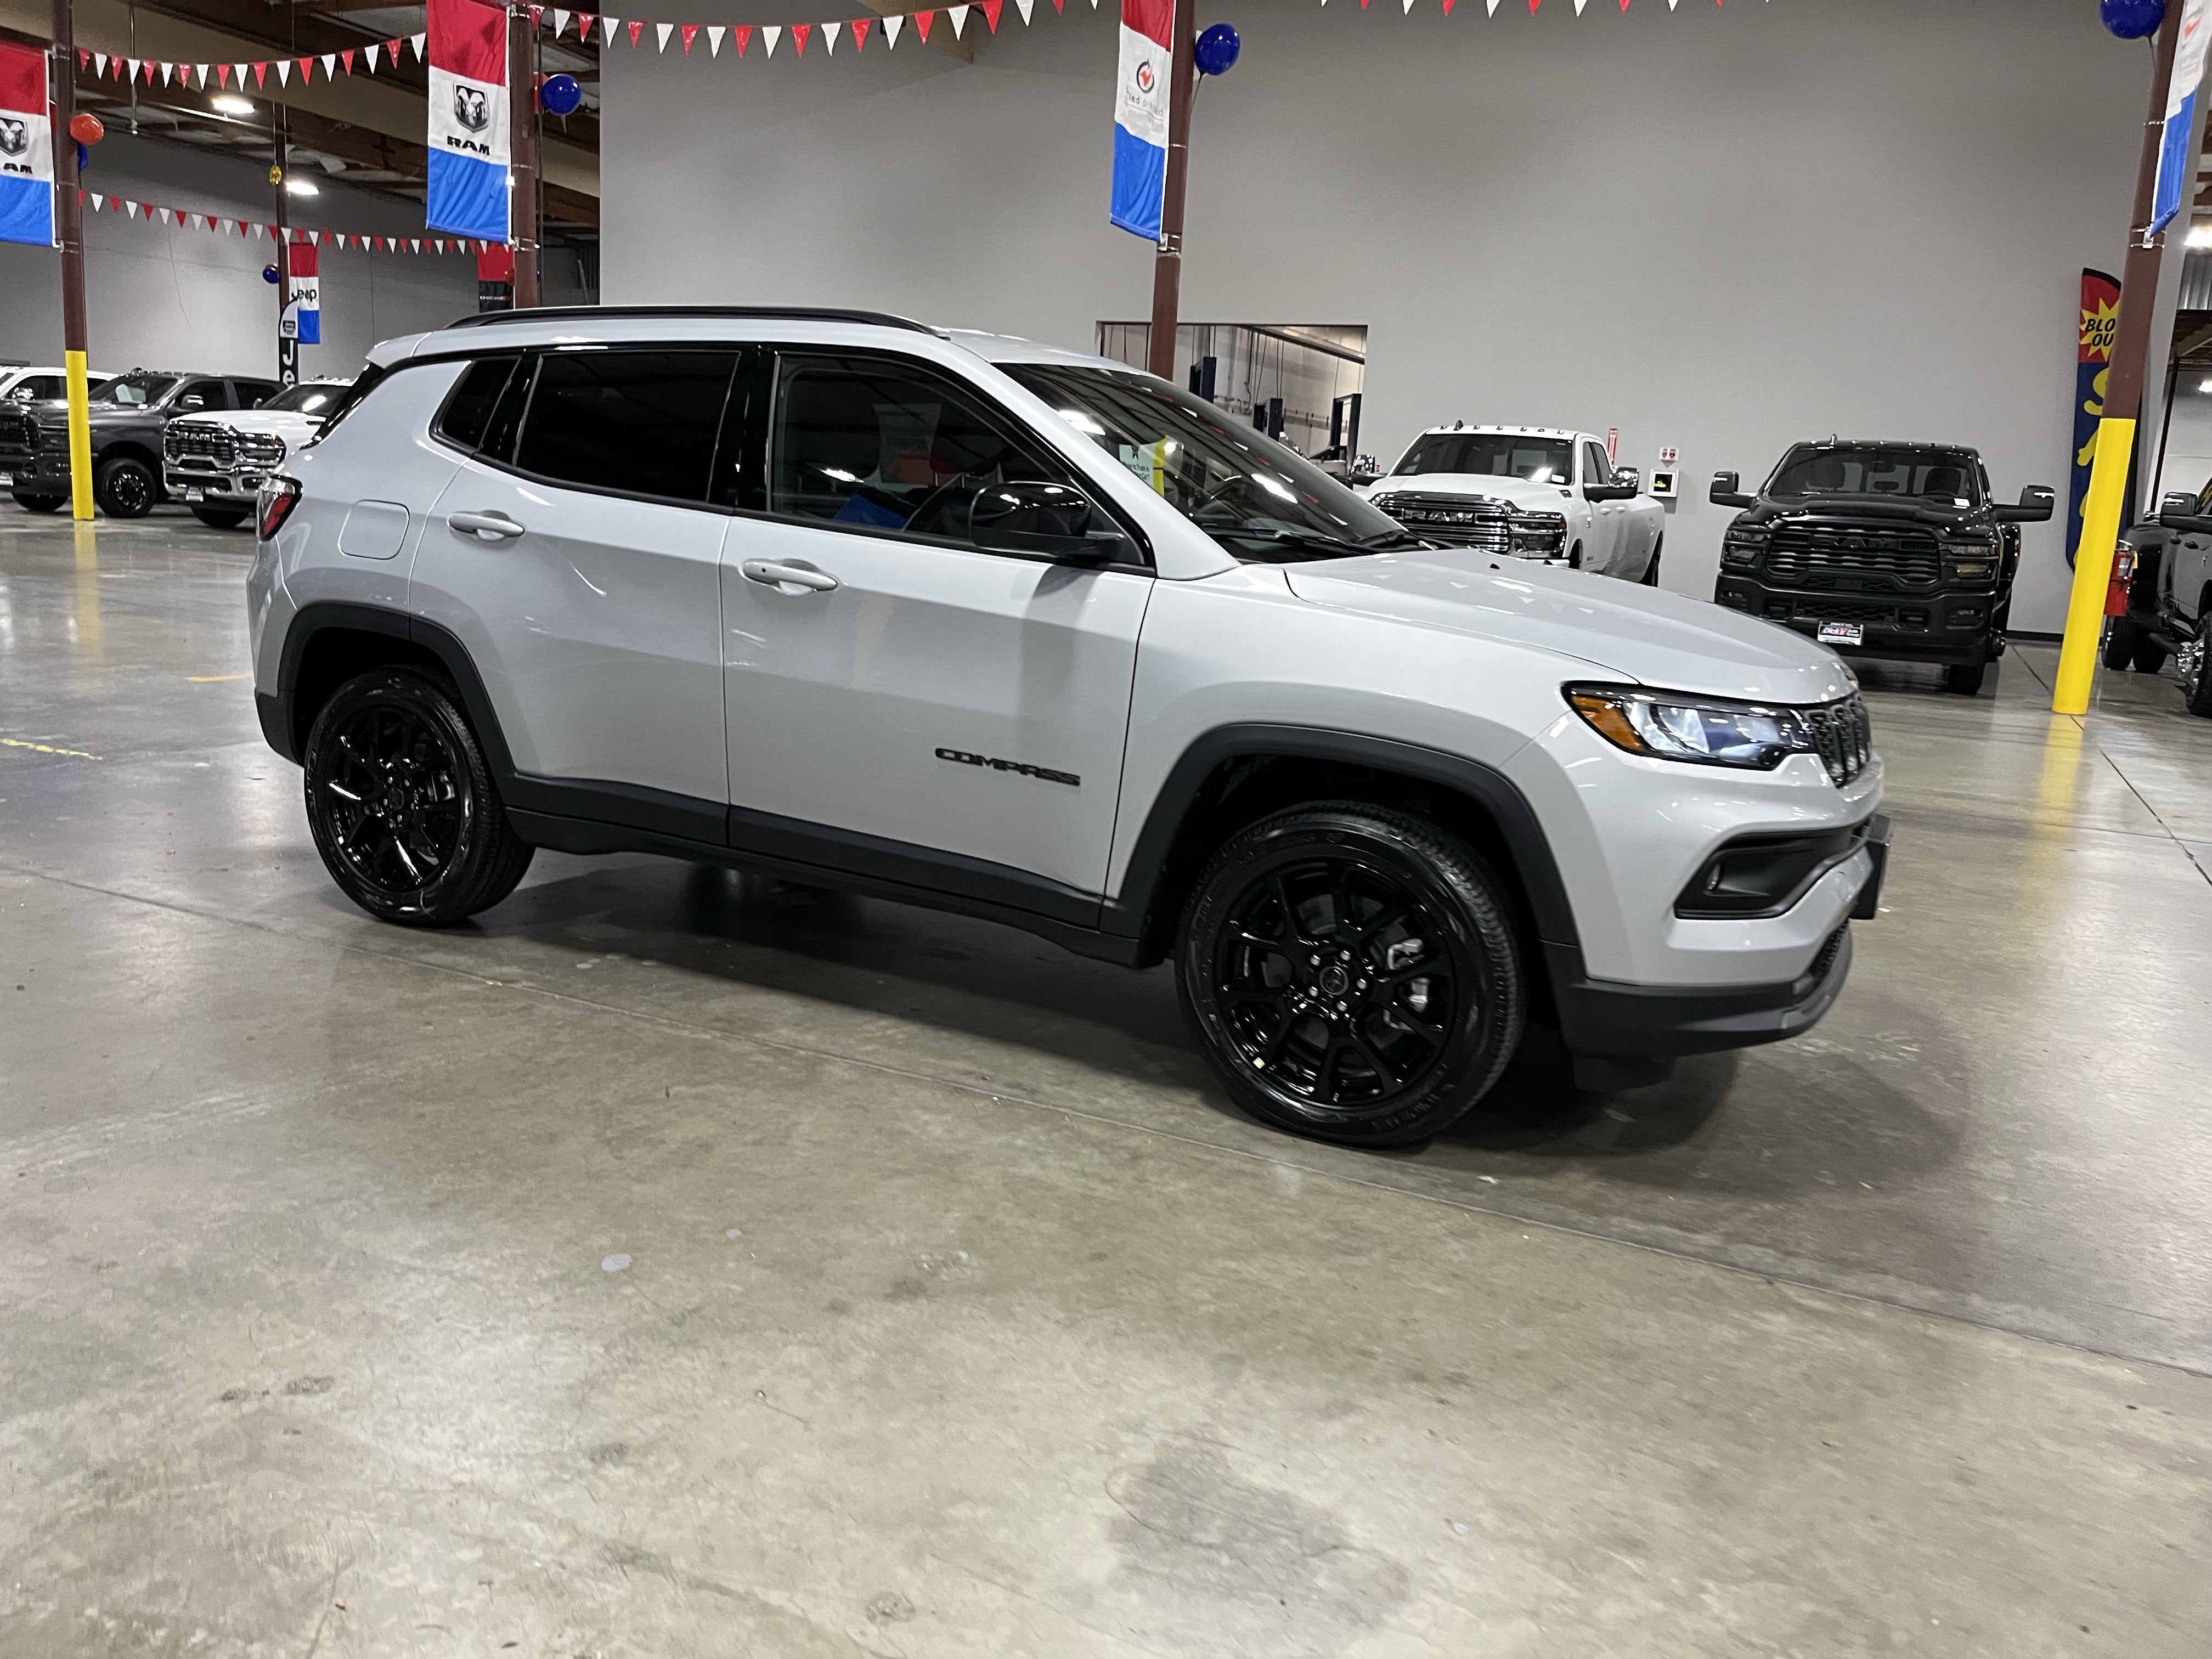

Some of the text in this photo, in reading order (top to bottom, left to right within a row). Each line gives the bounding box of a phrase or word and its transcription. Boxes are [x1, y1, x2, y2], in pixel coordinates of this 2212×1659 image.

[447, 136, 490, 156] RAM
[0, 163, 33, 174] AM
[2085, 318, 2116, 332] BLO
[2092, 333, 2114, 347] OU
[283, 340, 295, 386] Je
[1404, 509, 1473, 523] RAM
[935, 748, 1080, 786] COMPASS
